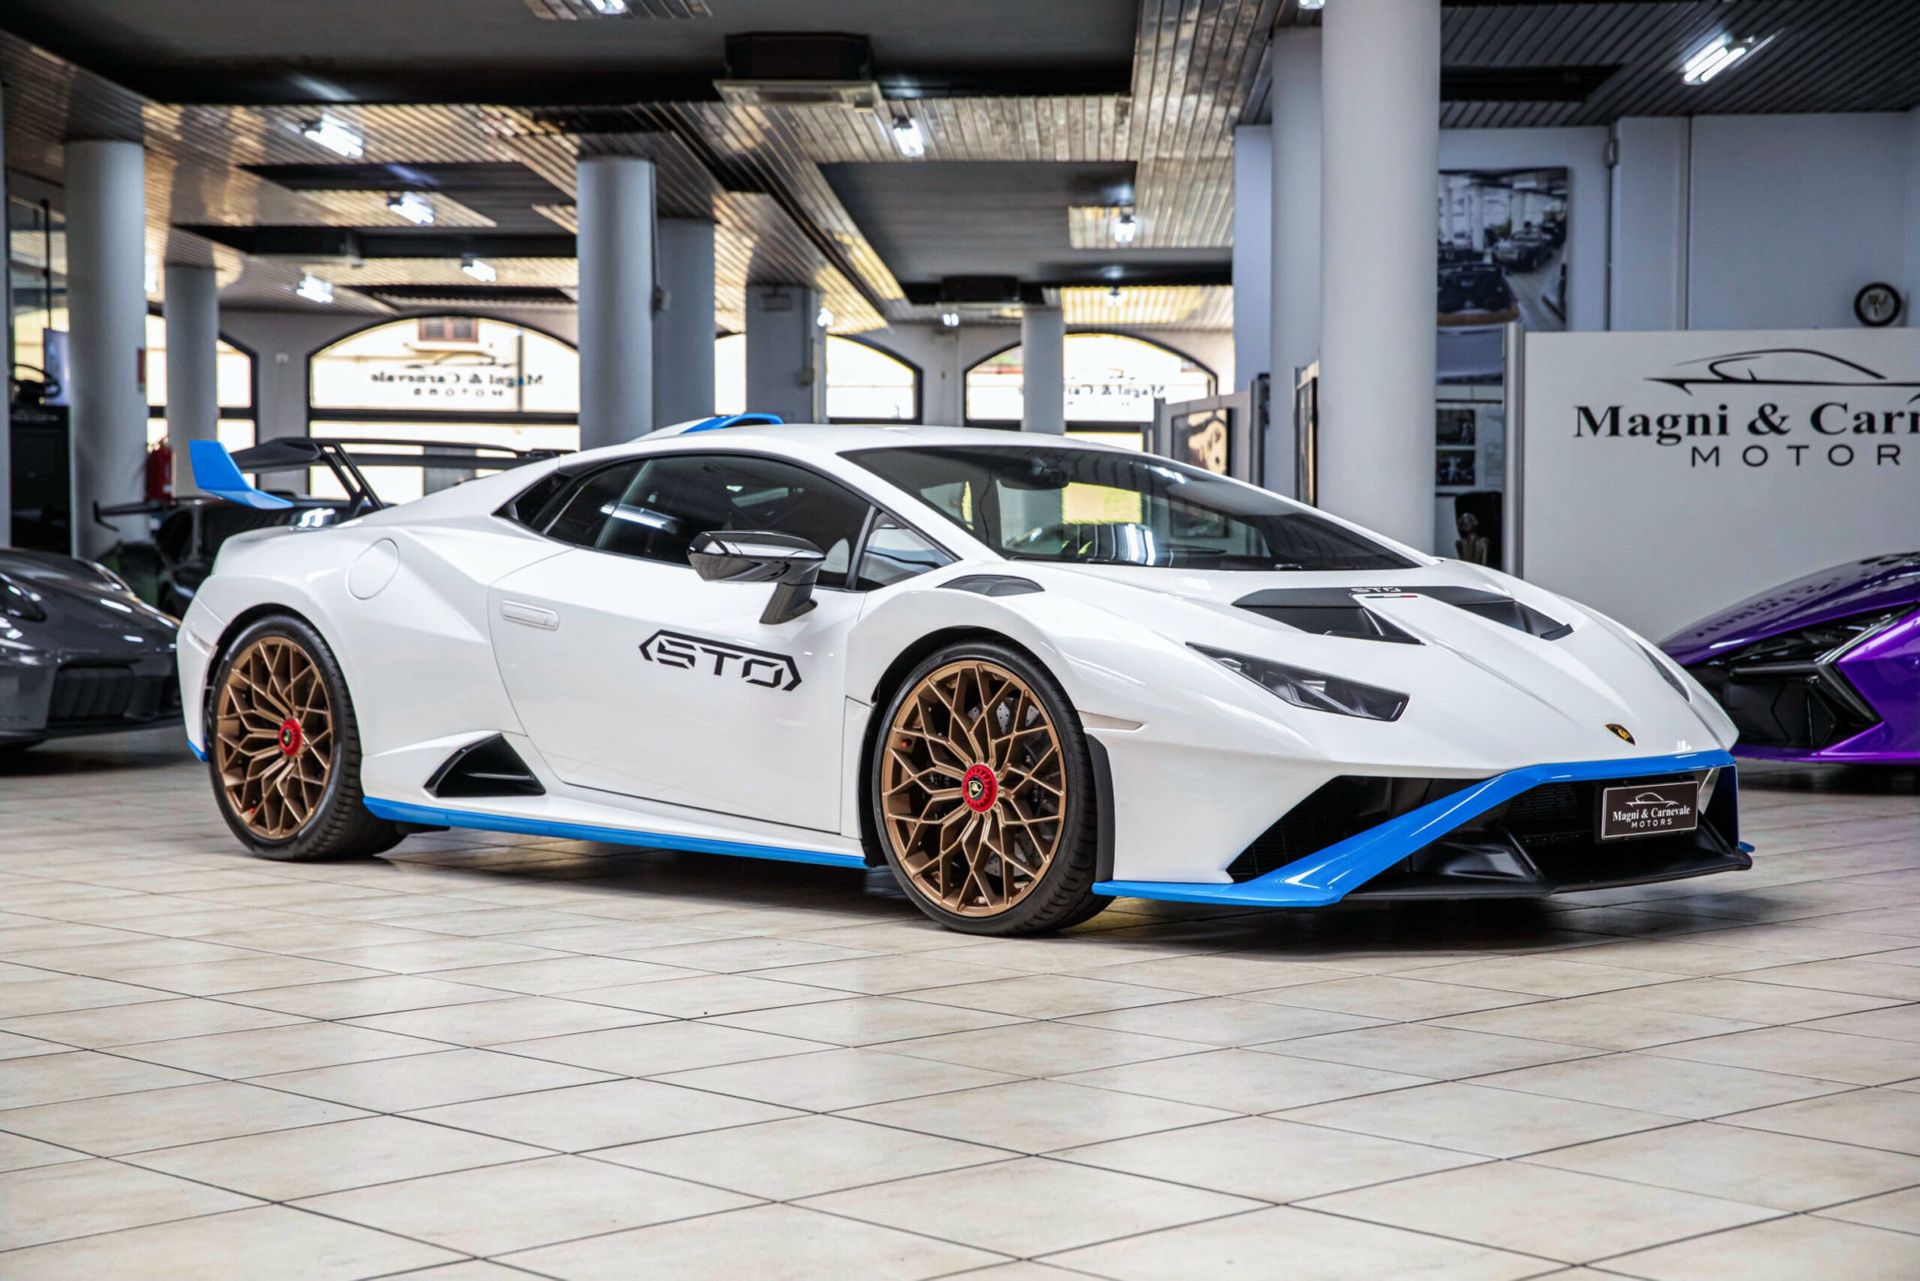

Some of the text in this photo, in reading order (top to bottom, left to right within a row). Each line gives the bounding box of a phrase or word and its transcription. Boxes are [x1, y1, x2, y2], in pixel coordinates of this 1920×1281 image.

[1572, 402, 1730, 446] Magni
[1747, 402, 1791, 436] &
[656, 638, 784, 688] STO
[1612, 804, 1691, 823] Magni & Carnevale
[1630, 818, 1673, 828] MOTORS
